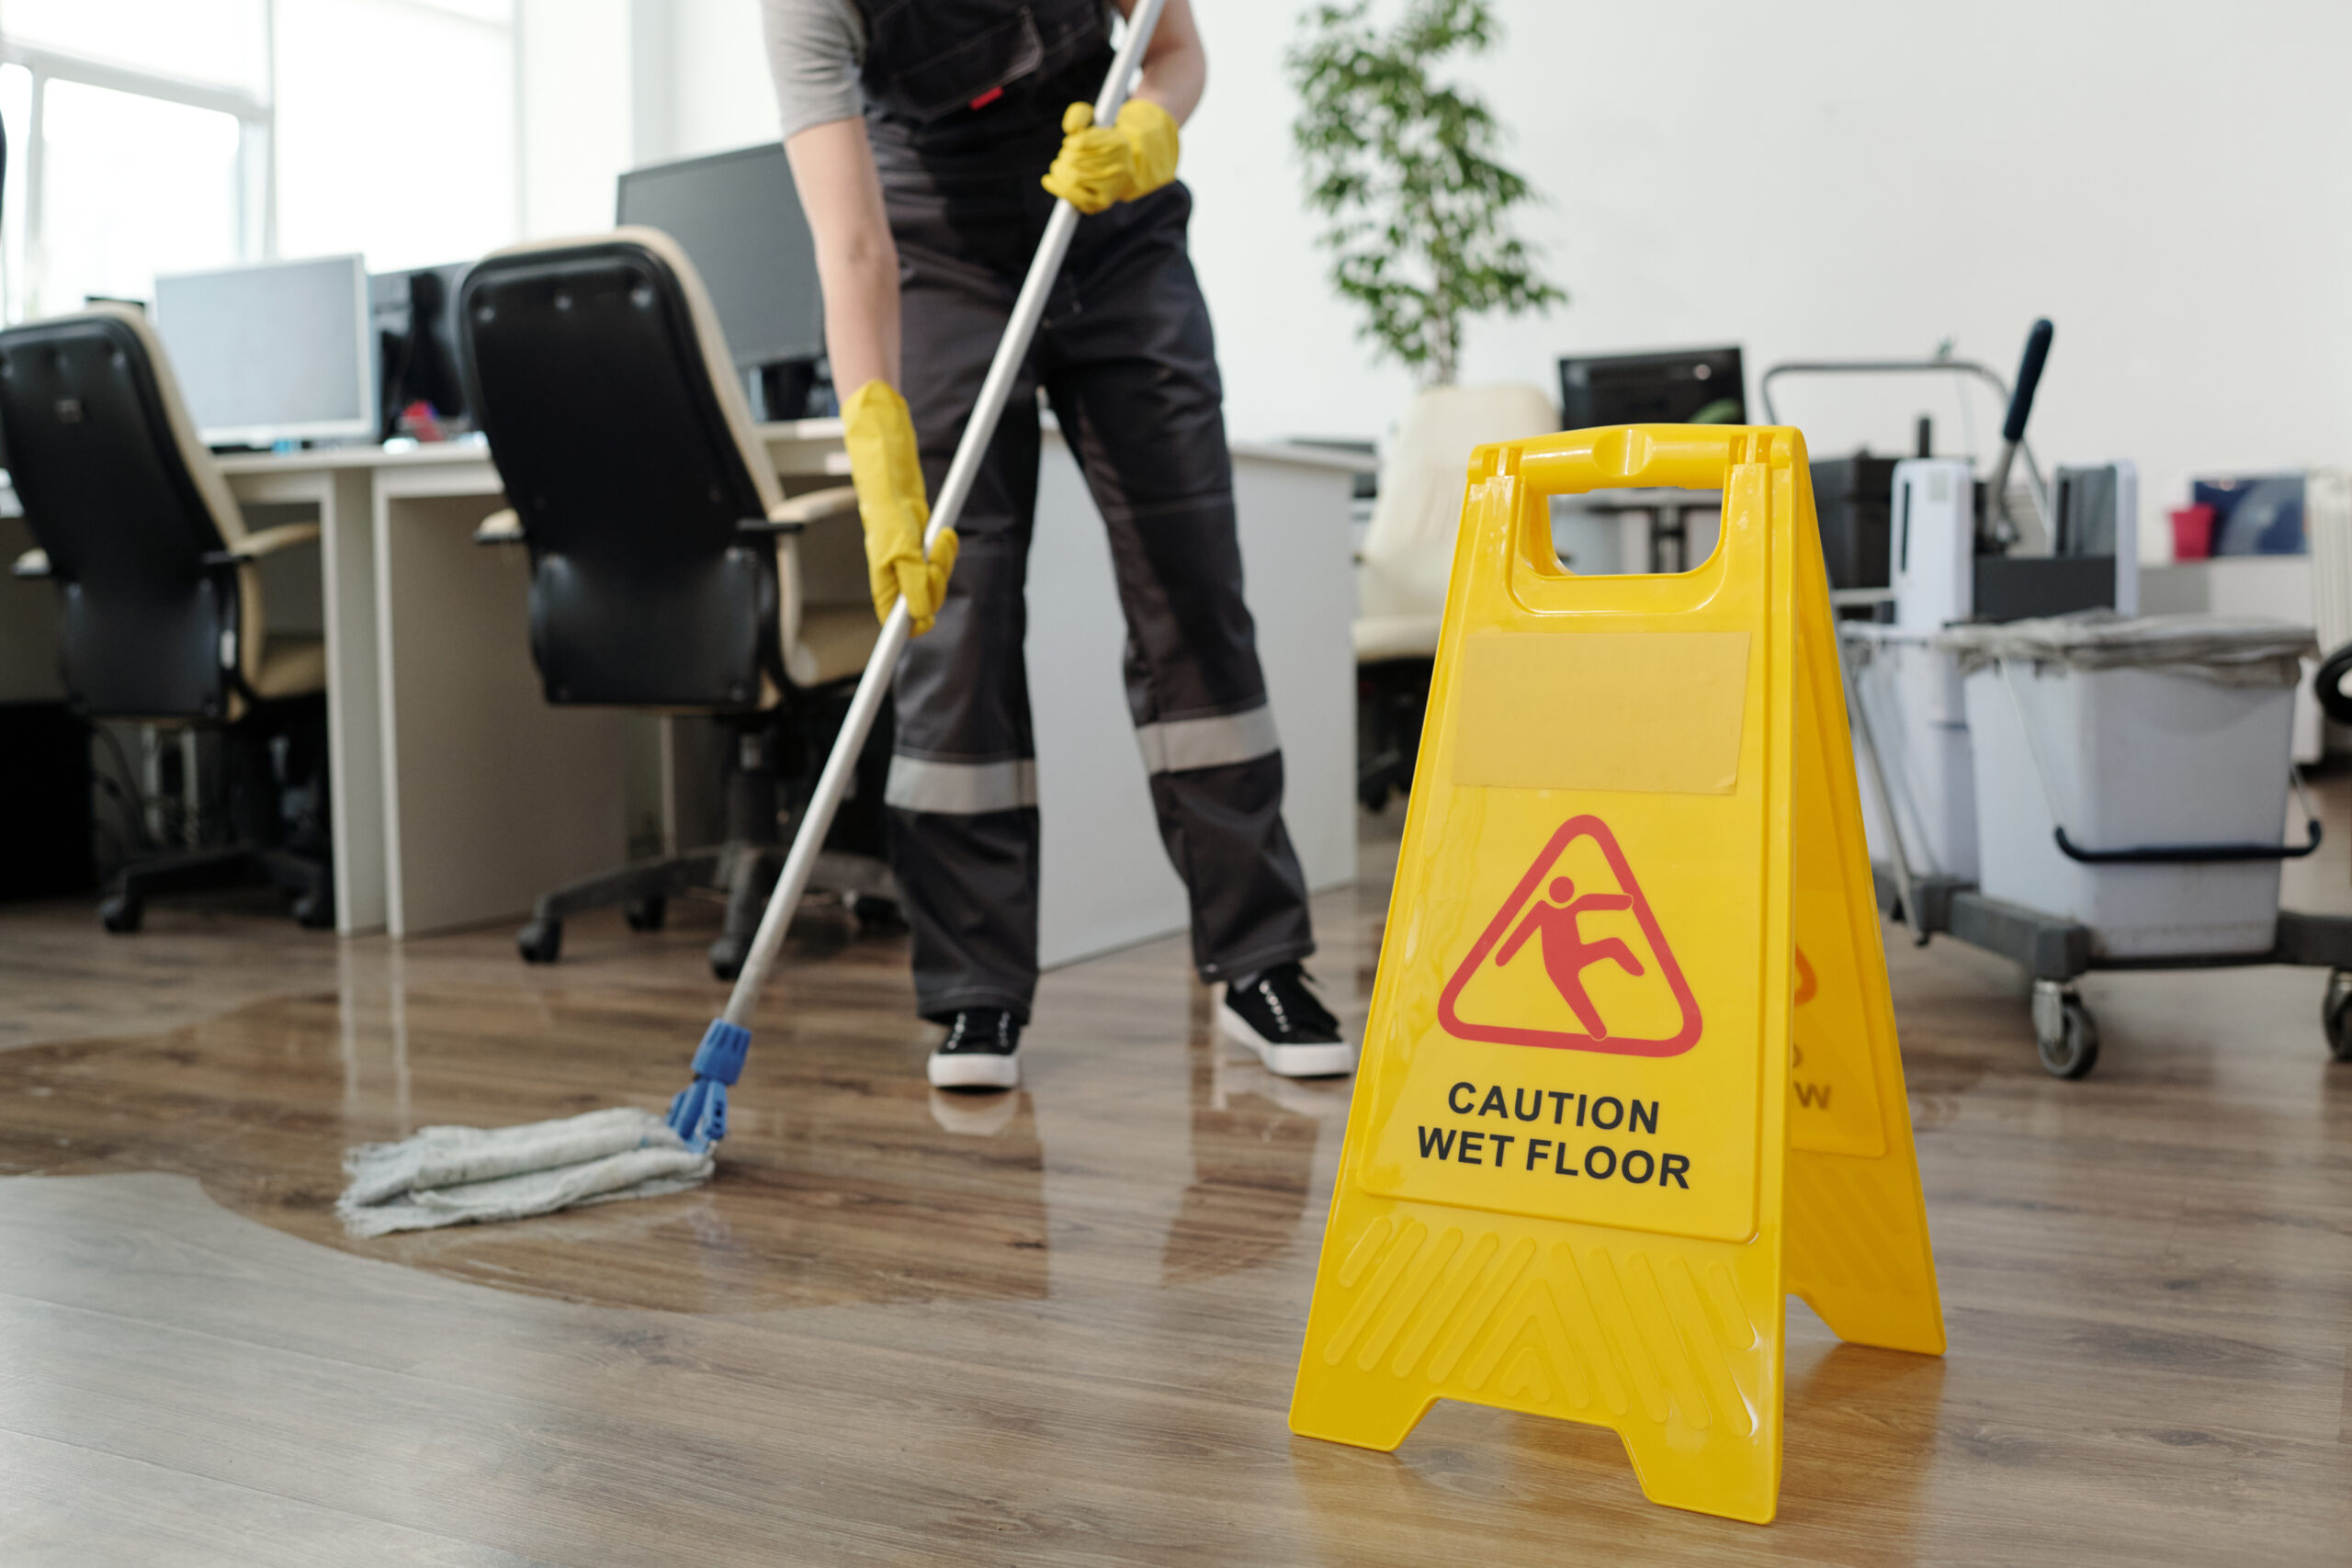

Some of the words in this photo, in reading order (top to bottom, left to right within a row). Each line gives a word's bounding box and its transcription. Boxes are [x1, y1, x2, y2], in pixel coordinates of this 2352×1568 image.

[1448, 1081, 1659, 1134] CAUTION
[1418, 1125, 1515, 1168] WET
[1526, 1138, 1690, 1190] FLOOR
